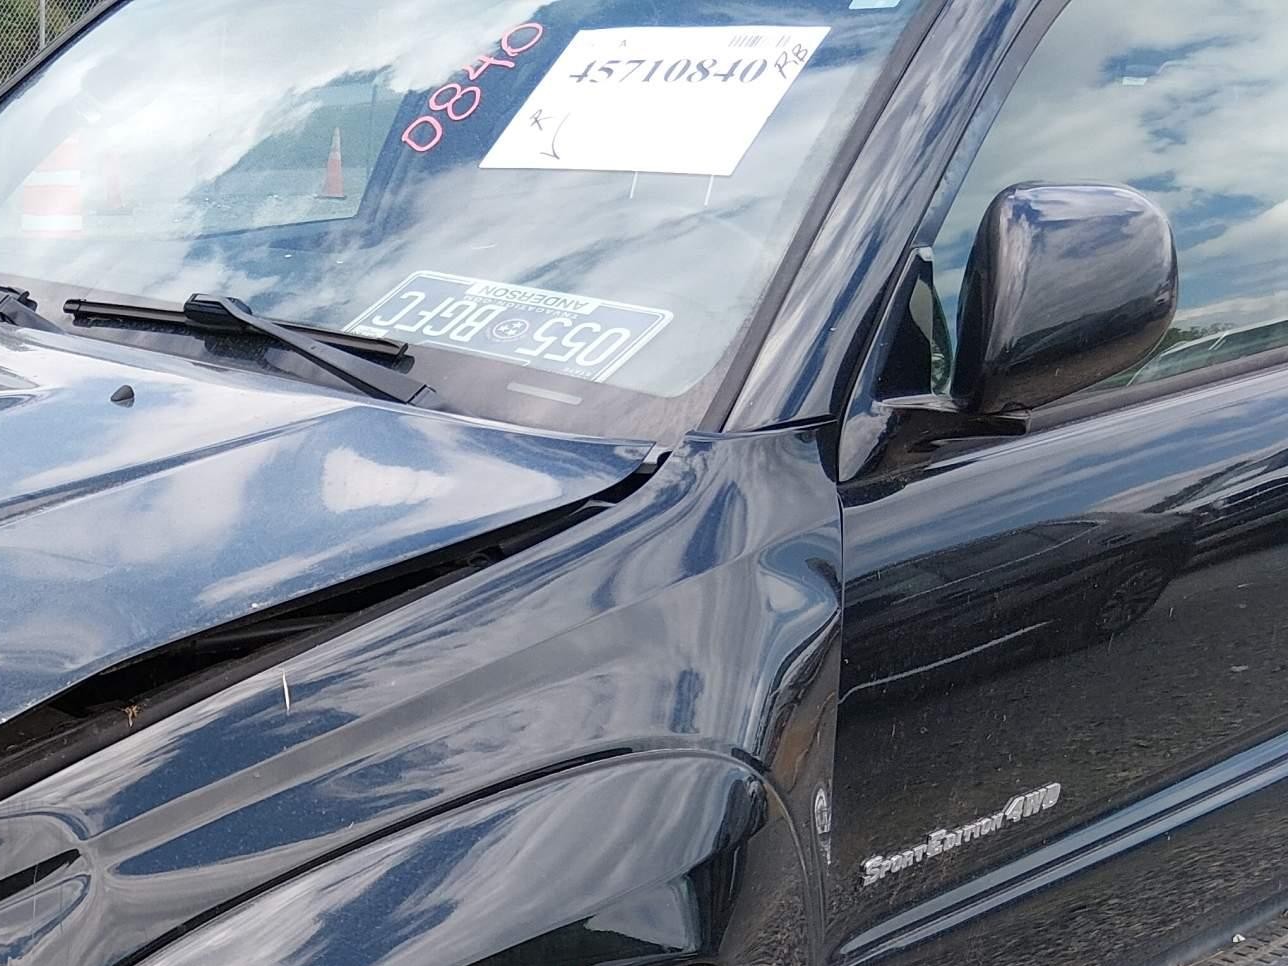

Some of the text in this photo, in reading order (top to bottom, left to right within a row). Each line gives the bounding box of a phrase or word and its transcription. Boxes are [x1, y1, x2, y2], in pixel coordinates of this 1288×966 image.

[401, 22, 544, 153] 0840
[568, 57, 769, 84] 45710840
[478, 285, 590, 311] ANDERSON
[371, 290, 631, 367] 055 BGFC
[1003, 782, 1062, 824] 4WD
